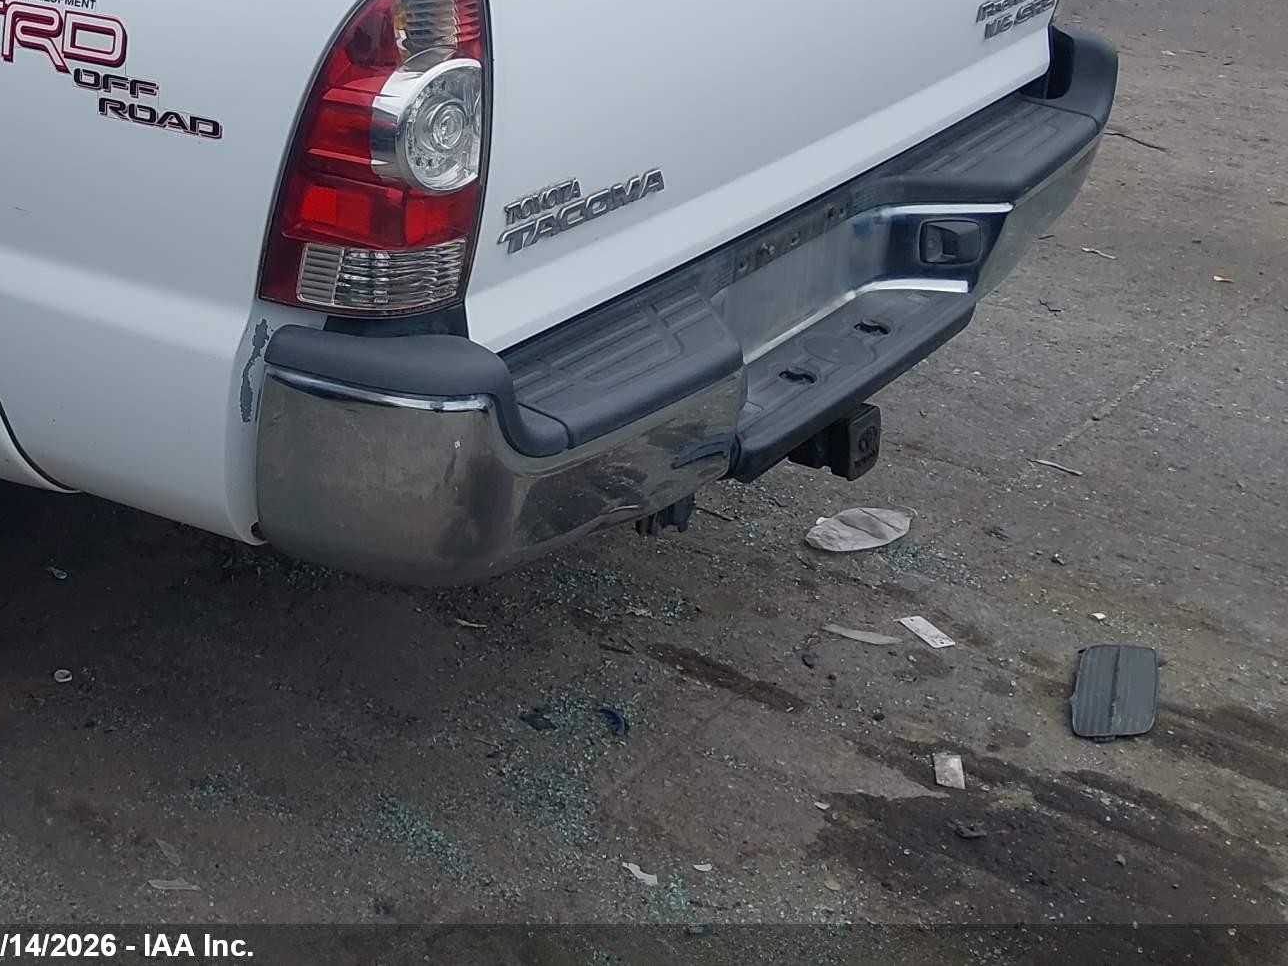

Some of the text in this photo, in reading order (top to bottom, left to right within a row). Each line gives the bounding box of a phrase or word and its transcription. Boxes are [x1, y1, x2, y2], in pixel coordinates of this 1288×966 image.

[73, 67, 160, 98] OFF
[98, 97, 223, 139] ROAD
[497, 168, 665, 255] TACOMA
[504, 177, 581, 224] TOYOTA
